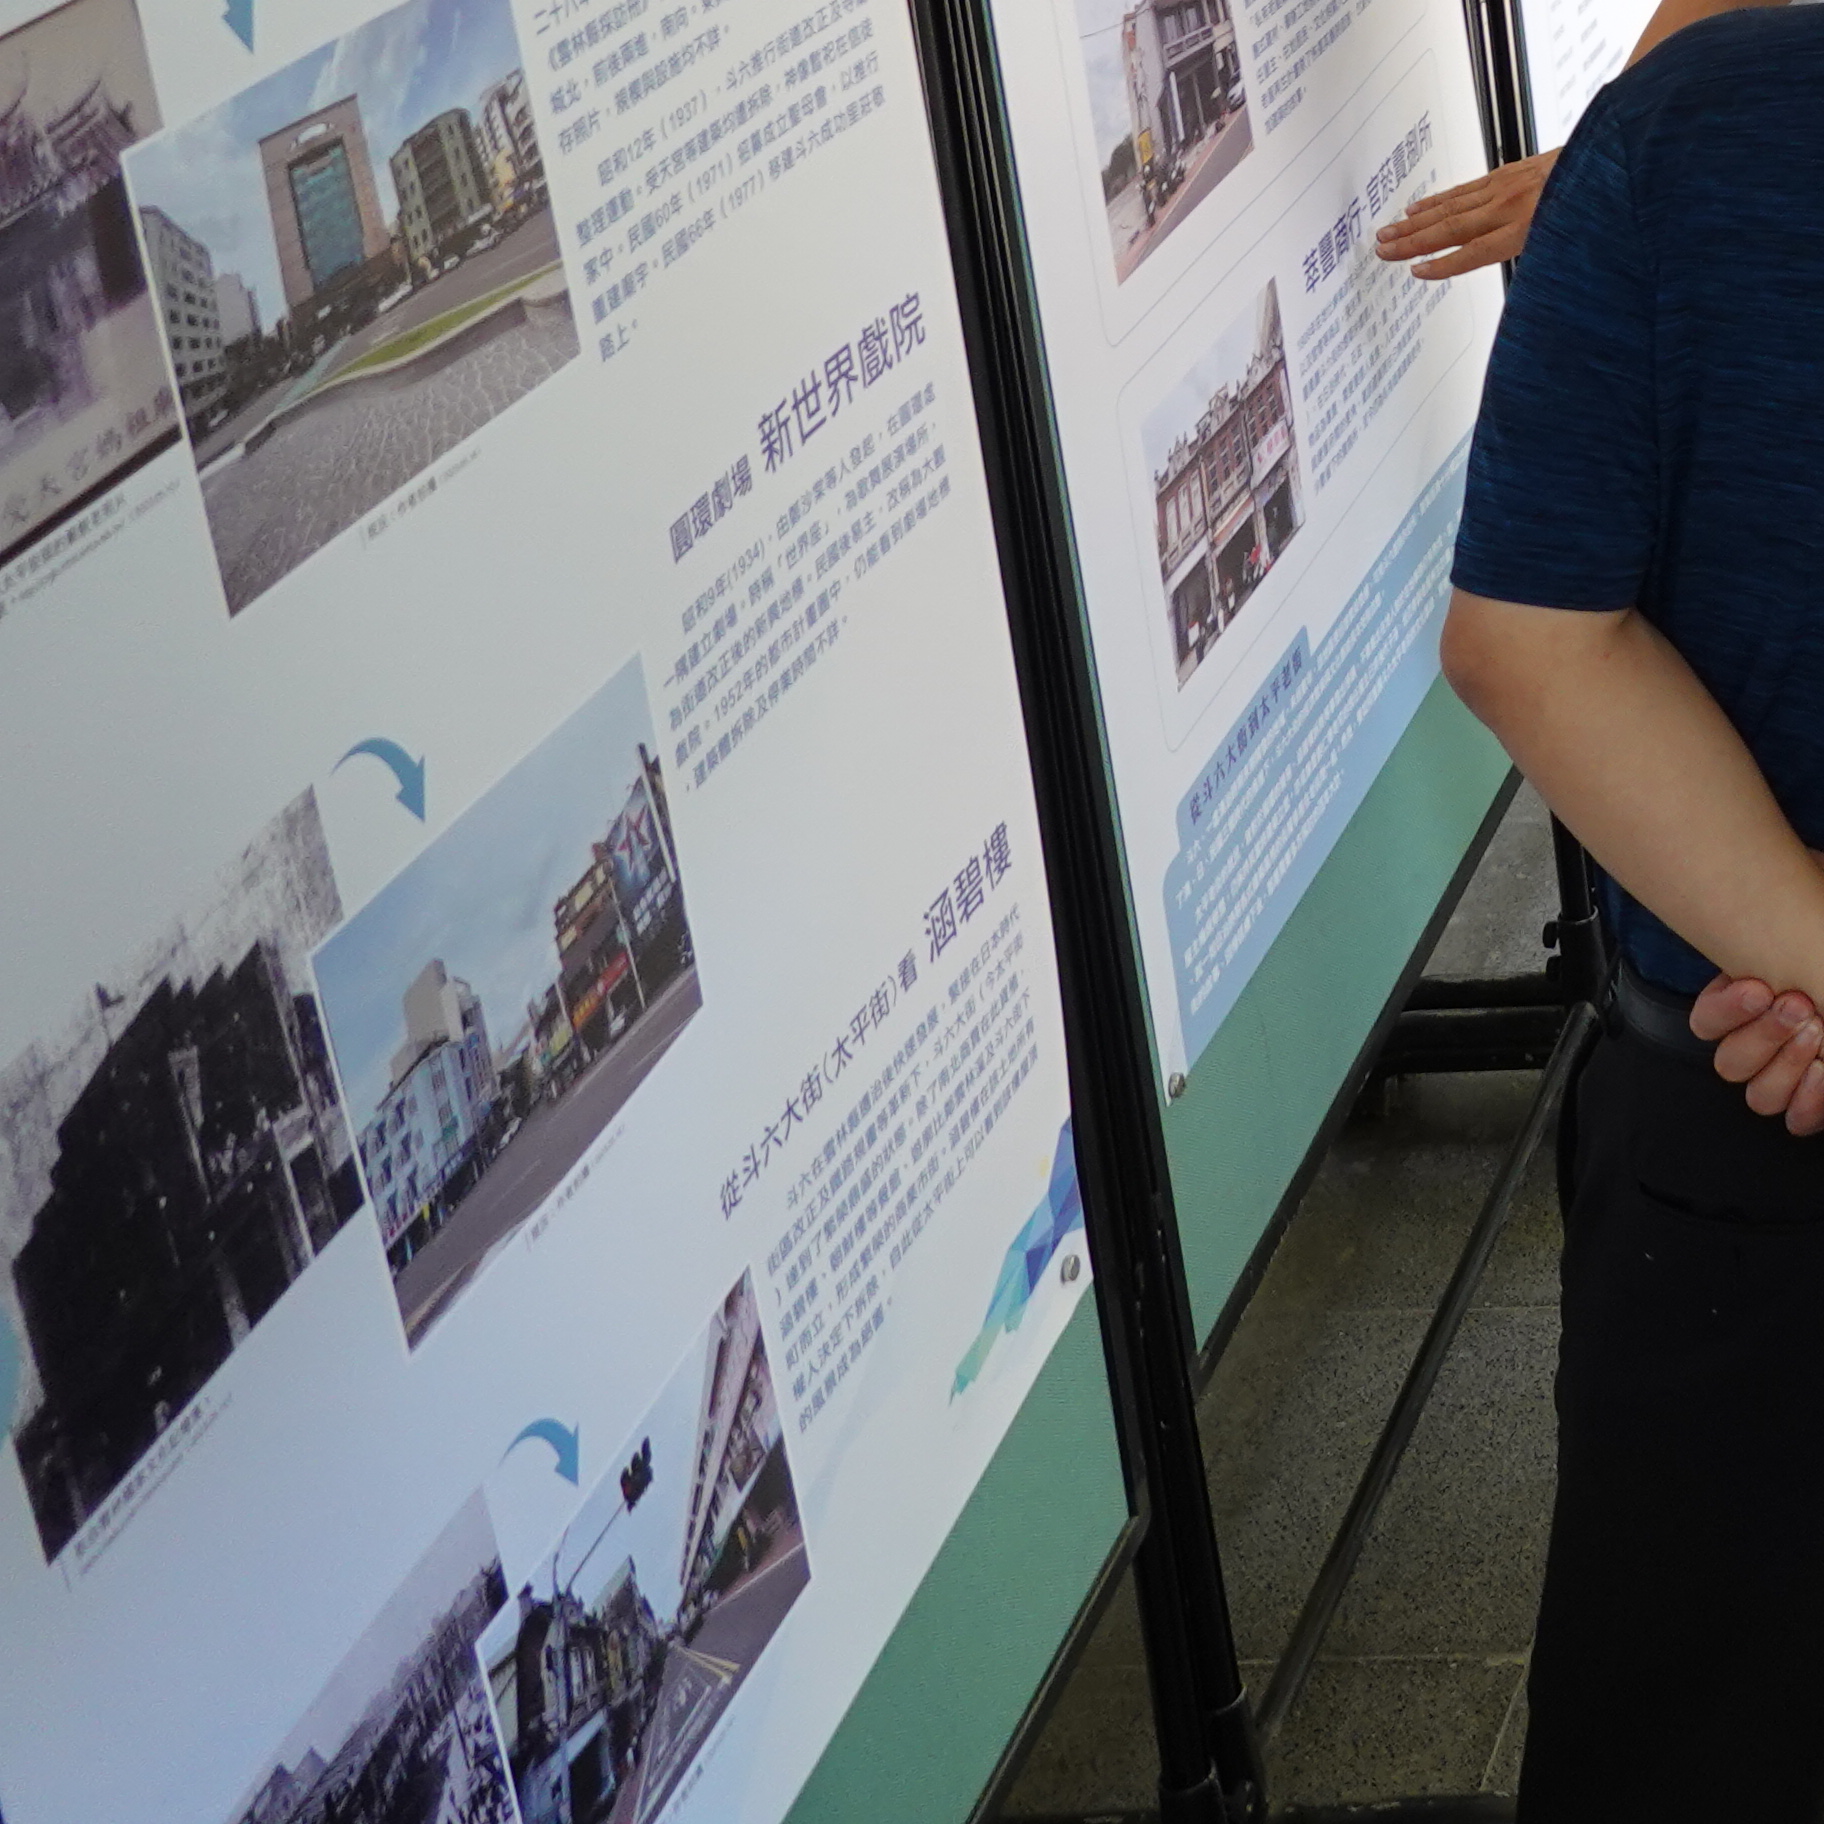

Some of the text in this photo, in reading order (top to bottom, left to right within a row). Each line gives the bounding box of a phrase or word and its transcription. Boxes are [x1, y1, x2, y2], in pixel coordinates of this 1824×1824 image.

[668, 290, 928, 566] 圓環劇場 新世界戲院
[719, 819, 1014, 1222] 從斗六大街(太平街)看 涵碧樓
